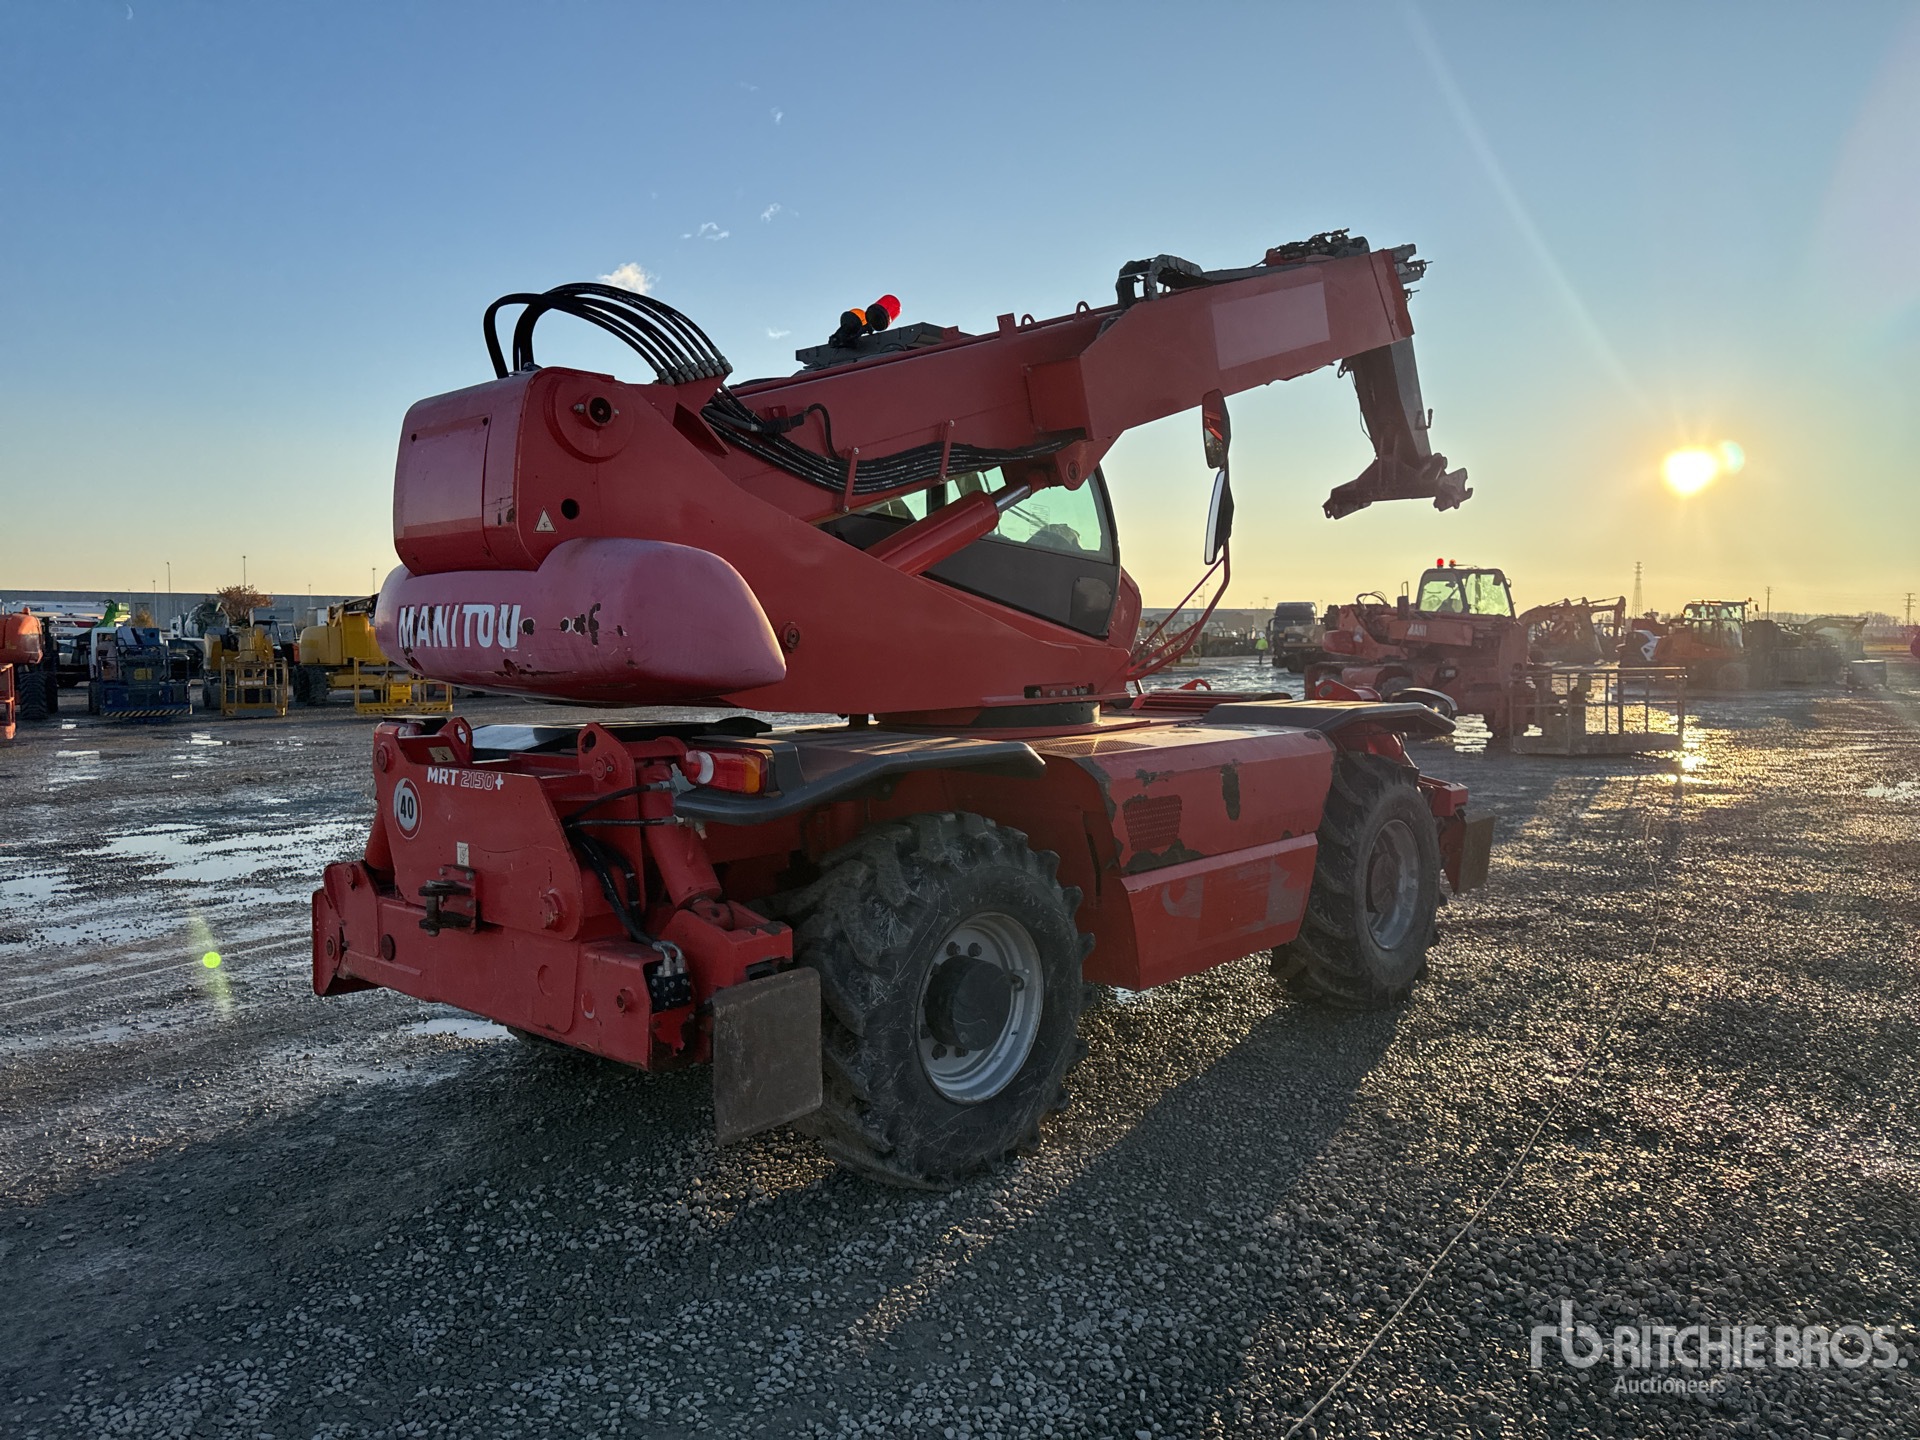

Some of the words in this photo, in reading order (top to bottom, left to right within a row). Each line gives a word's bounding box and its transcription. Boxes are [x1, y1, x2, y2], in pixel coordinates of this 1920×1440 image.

[398, 604, 521, 648] MANITOU
[427, 767, 459, 787] MRT
[400, 795, 415, 820] 40
